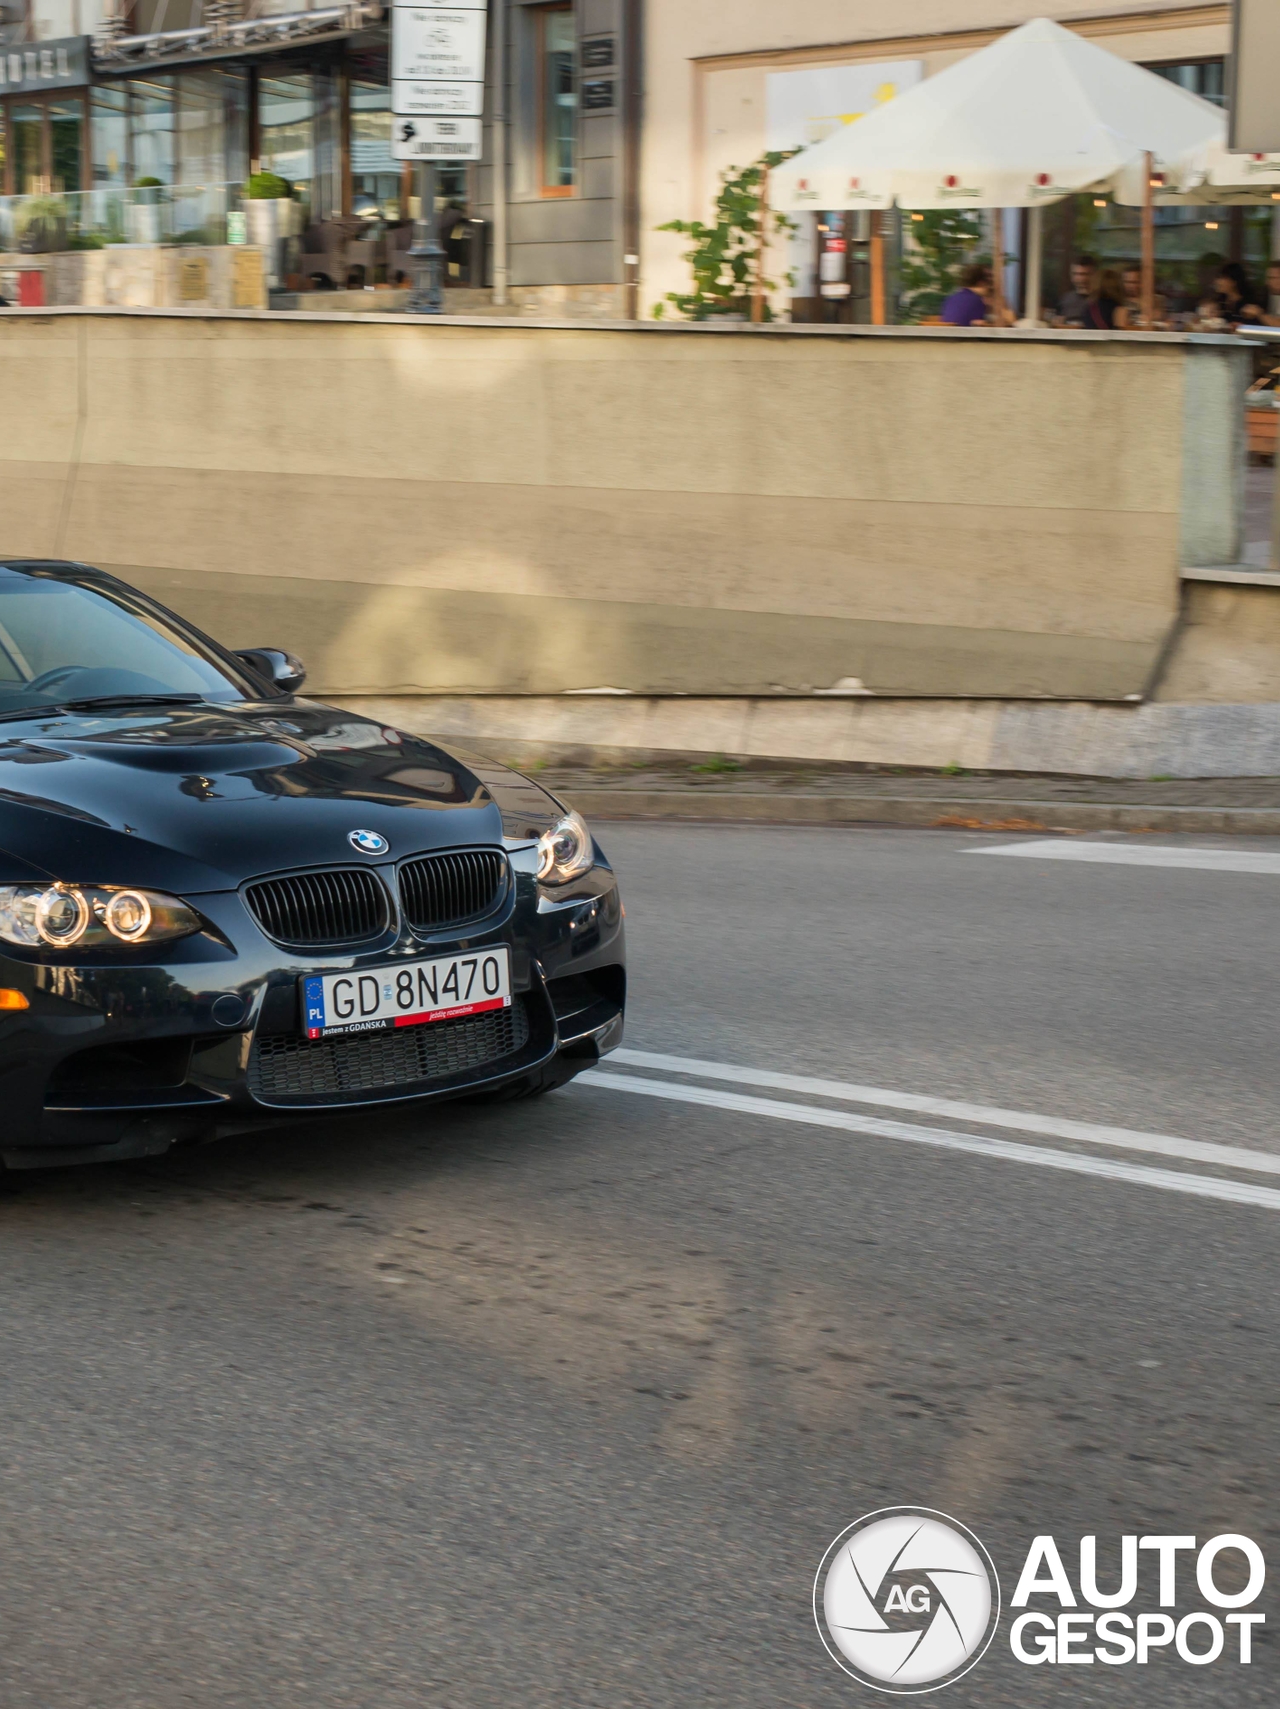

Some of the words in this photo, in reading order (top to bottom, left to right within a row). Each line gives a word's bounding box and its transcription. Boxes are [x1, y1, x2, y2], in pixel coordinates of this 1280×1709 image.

[333, 975, 380, 1019] GD
[396, 956, 500, 1010] 8N470
[309, 1008, 323, 1020] PL
[322, 1027, 344, 1036] jestem
[349, 1020, 387, 1032] GDAŃSKA
